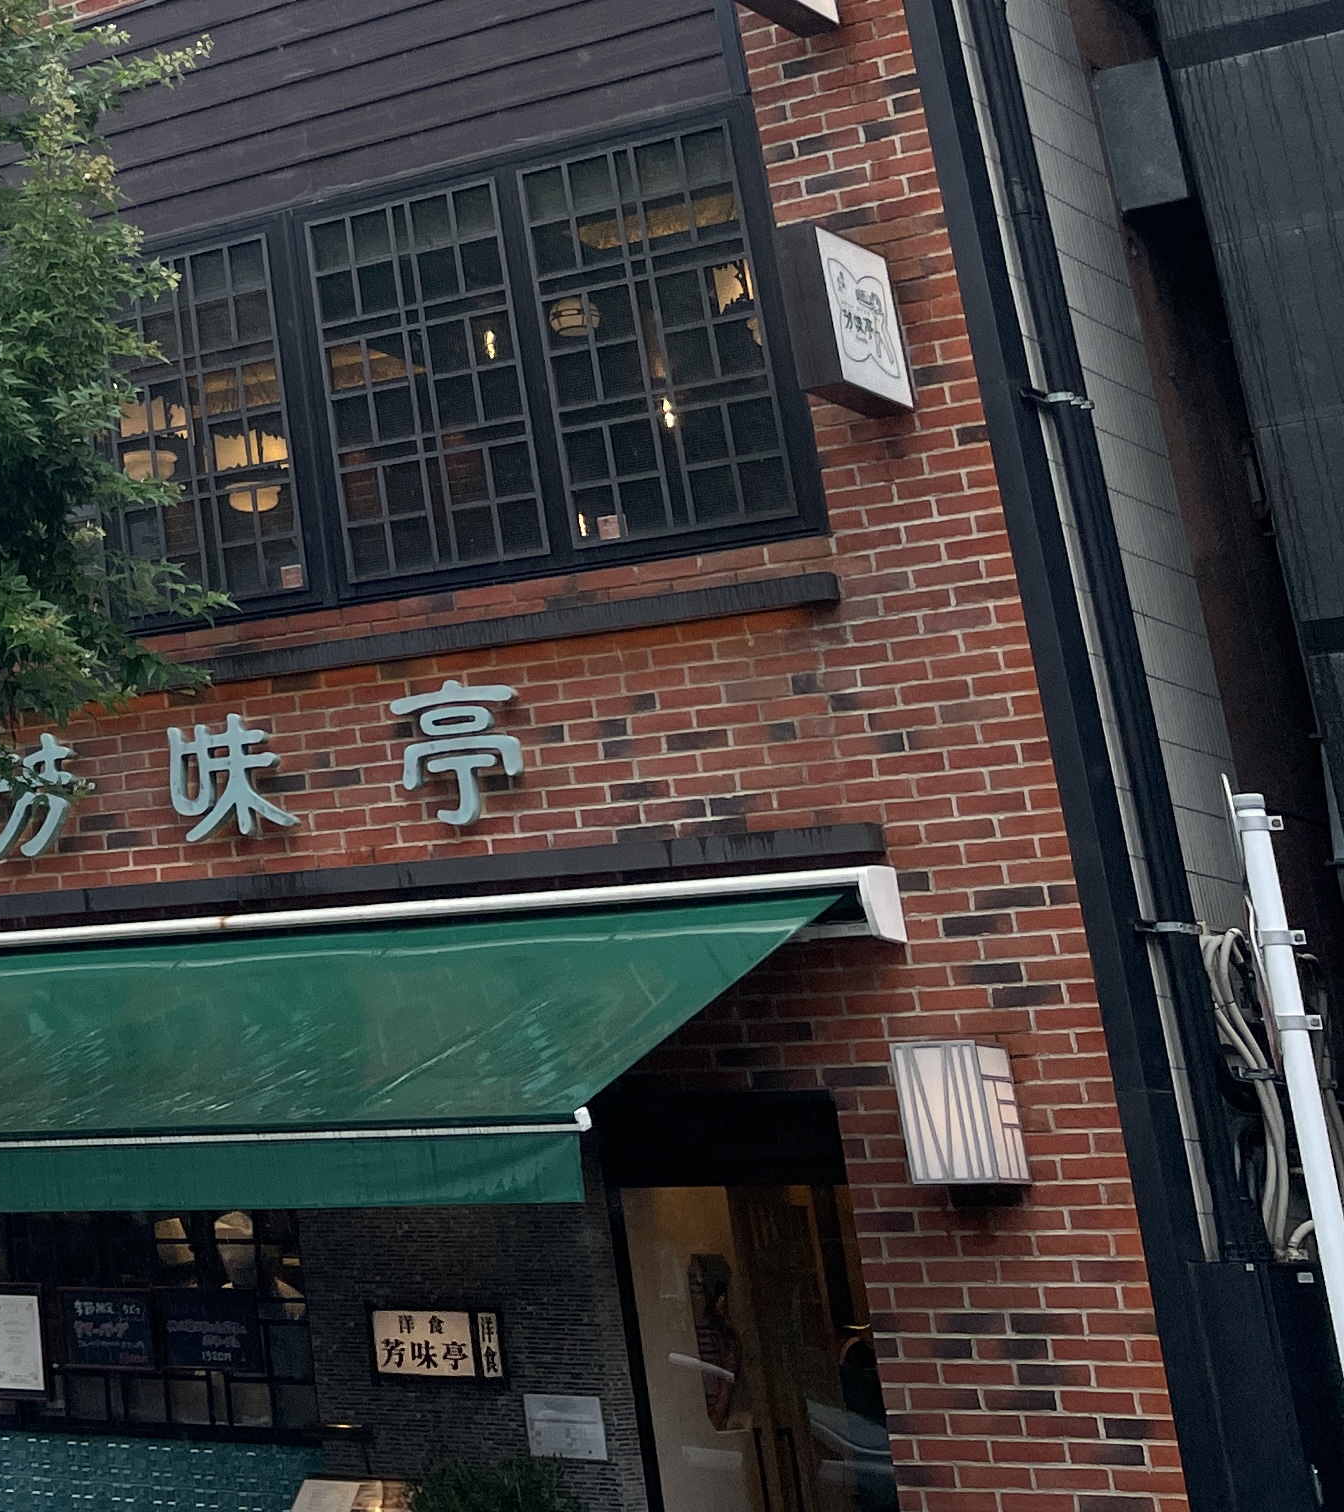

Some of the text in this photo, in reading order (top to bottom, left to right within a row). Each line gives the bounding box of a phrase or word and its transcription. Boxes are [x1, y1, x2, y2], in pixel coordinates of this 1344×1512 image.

[398, 1314, 445, 1334] 洋食
[381, 1338, 469, 1370] 芳味亭
